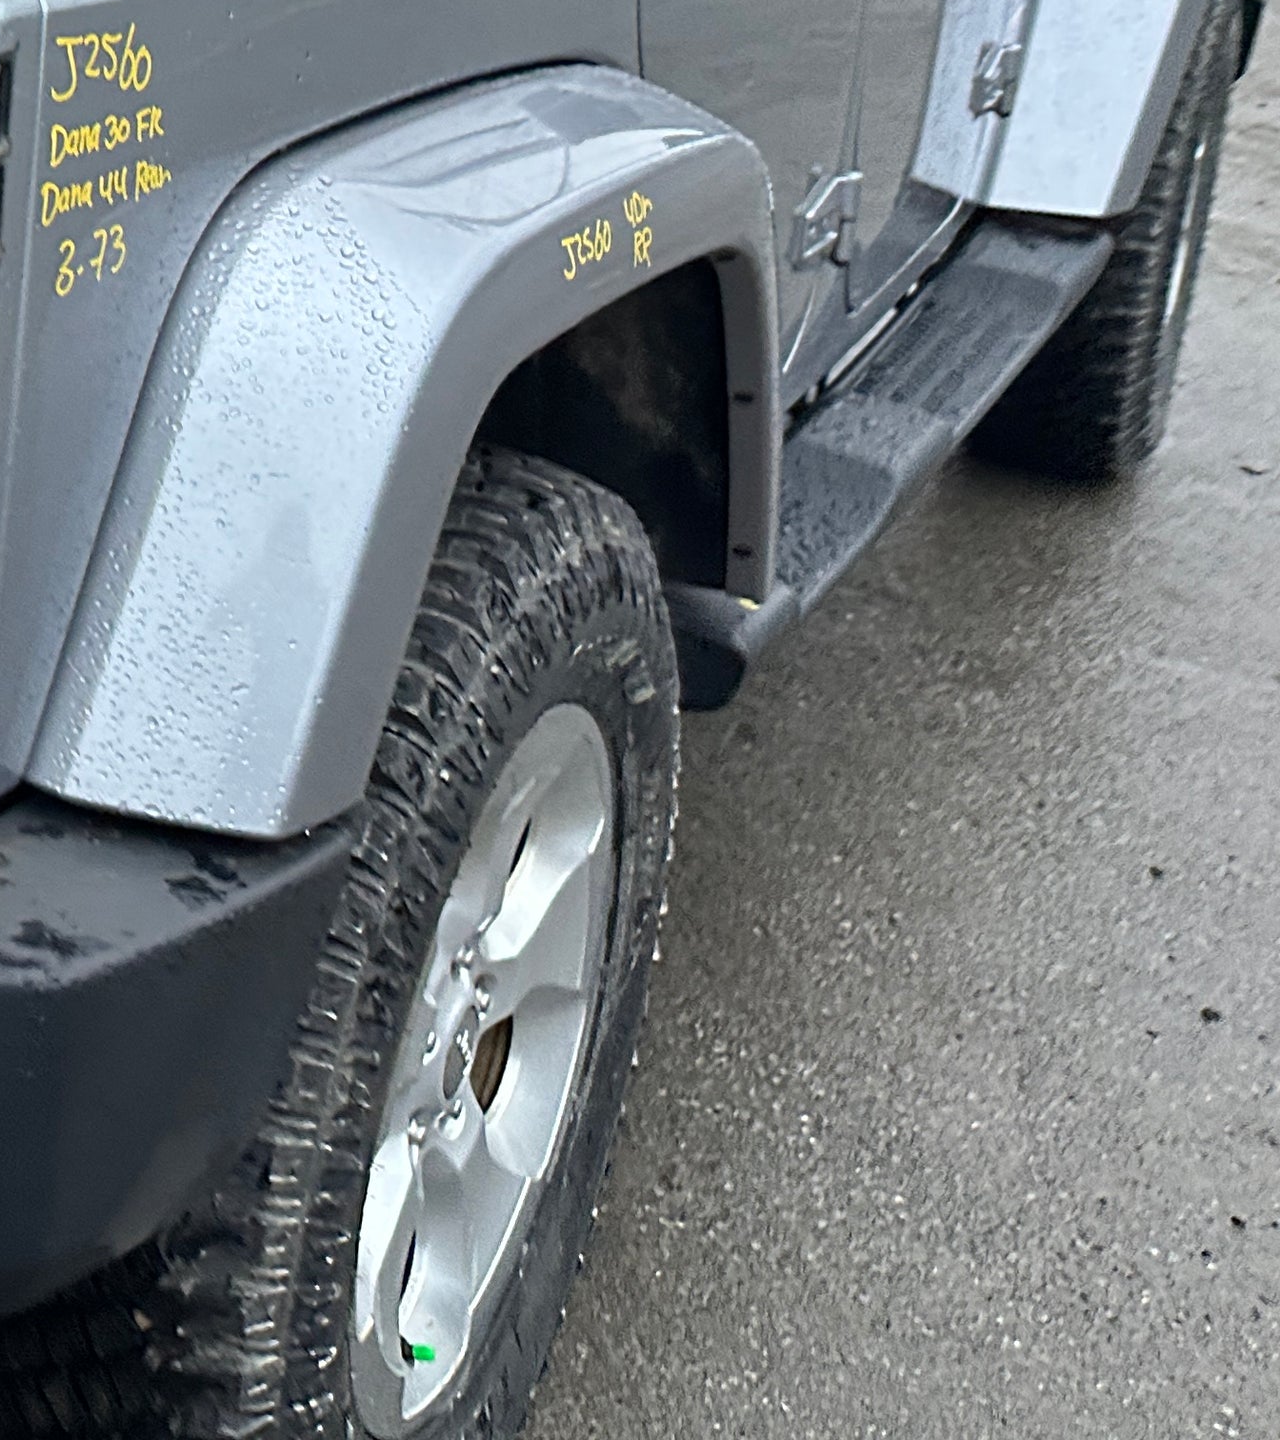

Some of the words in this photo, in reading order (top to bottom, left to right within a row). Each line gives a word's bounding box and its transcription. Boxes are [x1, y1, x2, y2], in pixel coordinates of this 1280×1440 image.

[51, 22, 153, 102] J2560
[50, 123, 101, 168] Dana
[104, 114, 132, 150] 30
[41, 181, 93, 227] Dana
[98, 166, 129, 205] 44
[560, 218, 612, 281] J2560
